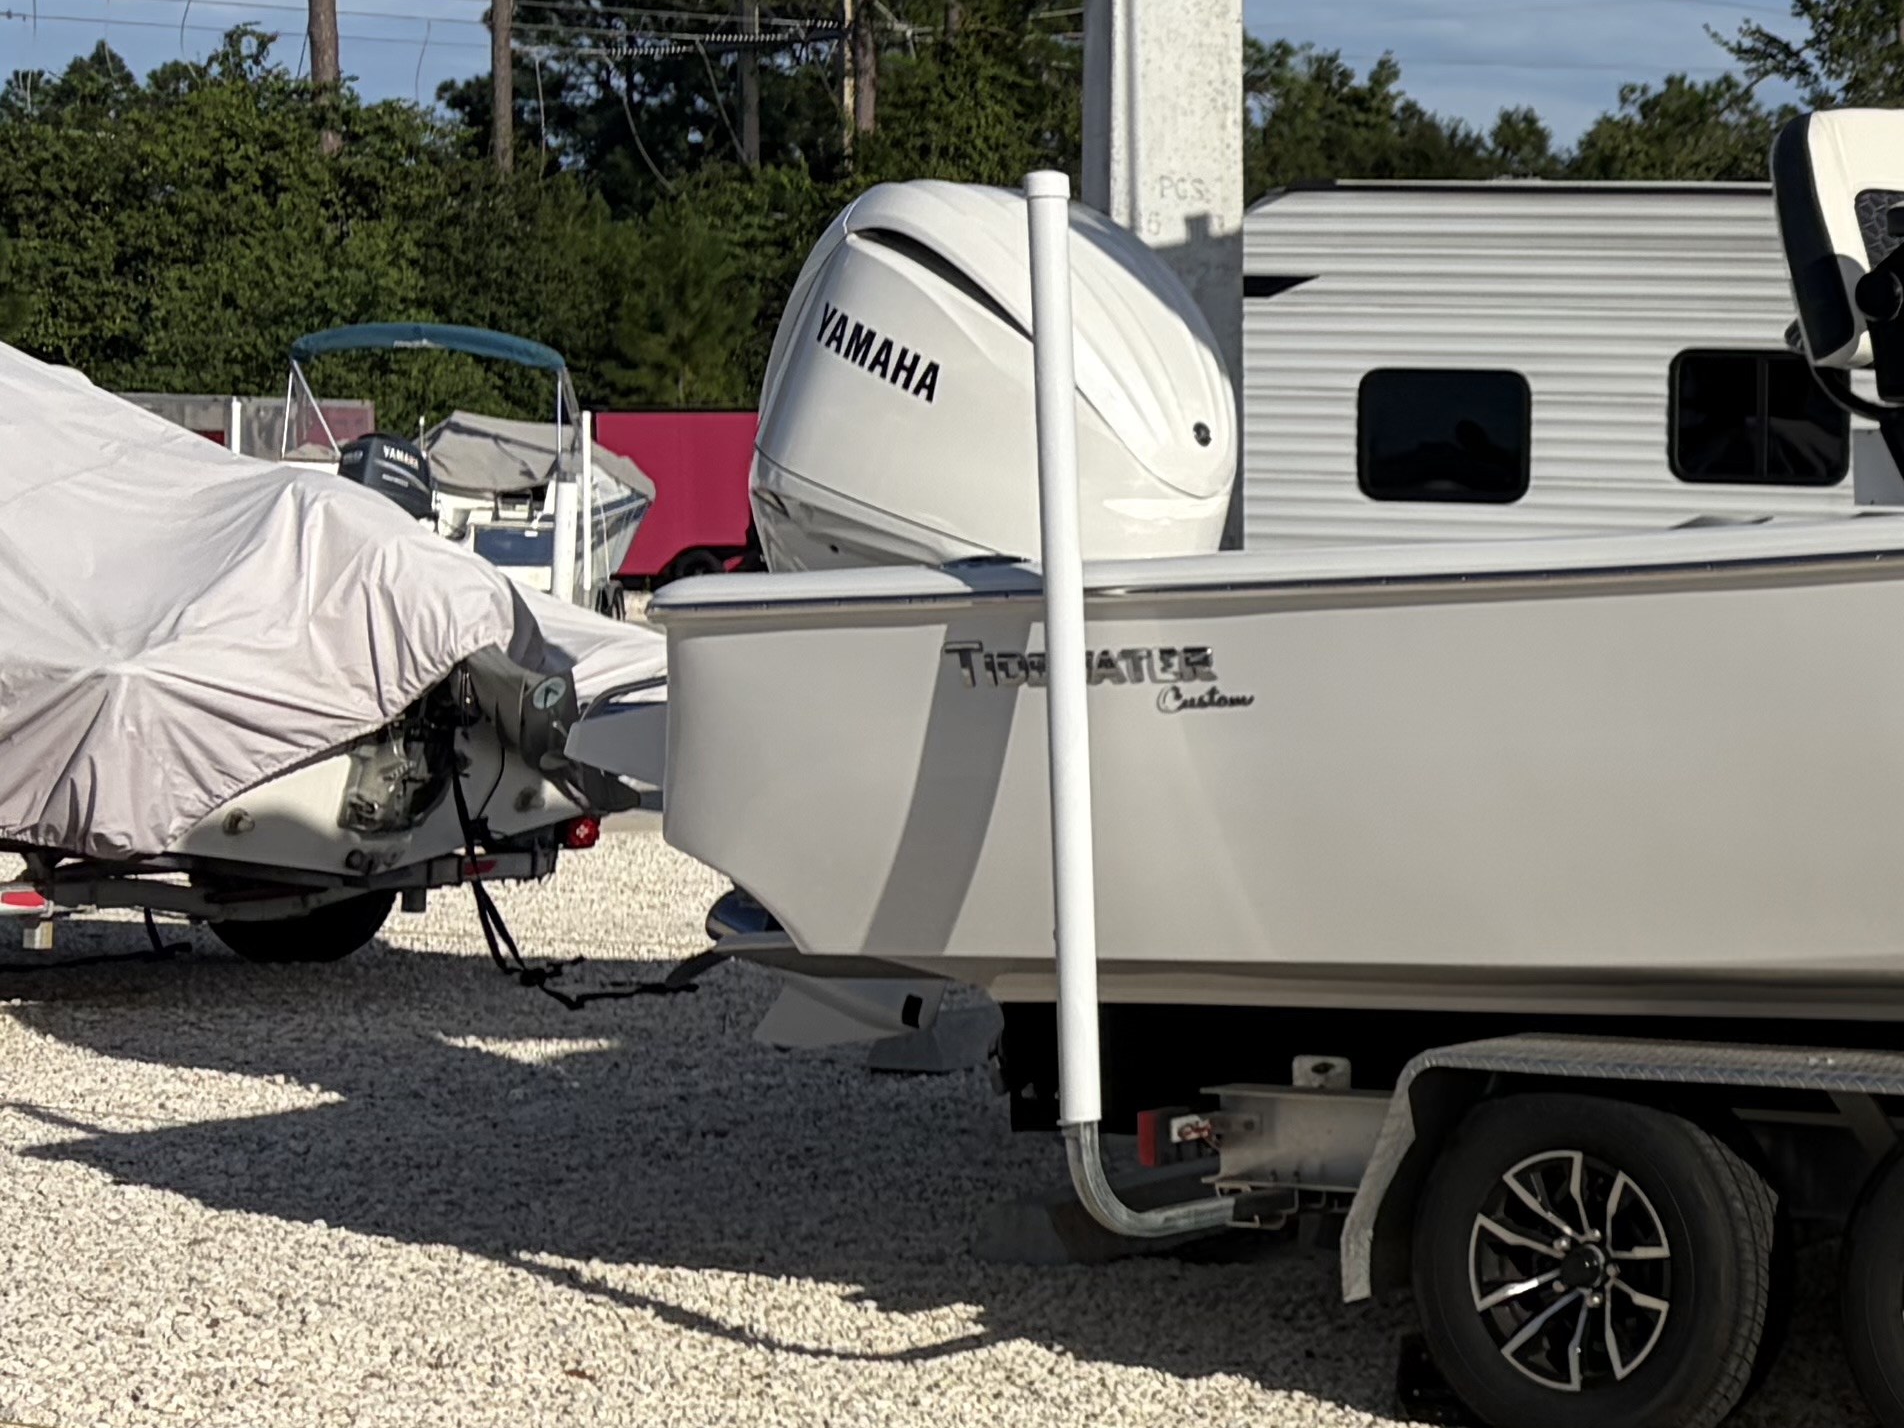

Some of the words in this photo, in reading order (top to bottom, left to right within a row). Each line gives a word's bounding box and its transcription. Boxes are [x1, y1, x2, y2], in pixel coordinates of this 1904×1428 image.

[816, 300, 940, 404] YAMAHA
[942, 640, 1218, 688] TIDEATER
[1157, 685, 1255, 713] Custom
